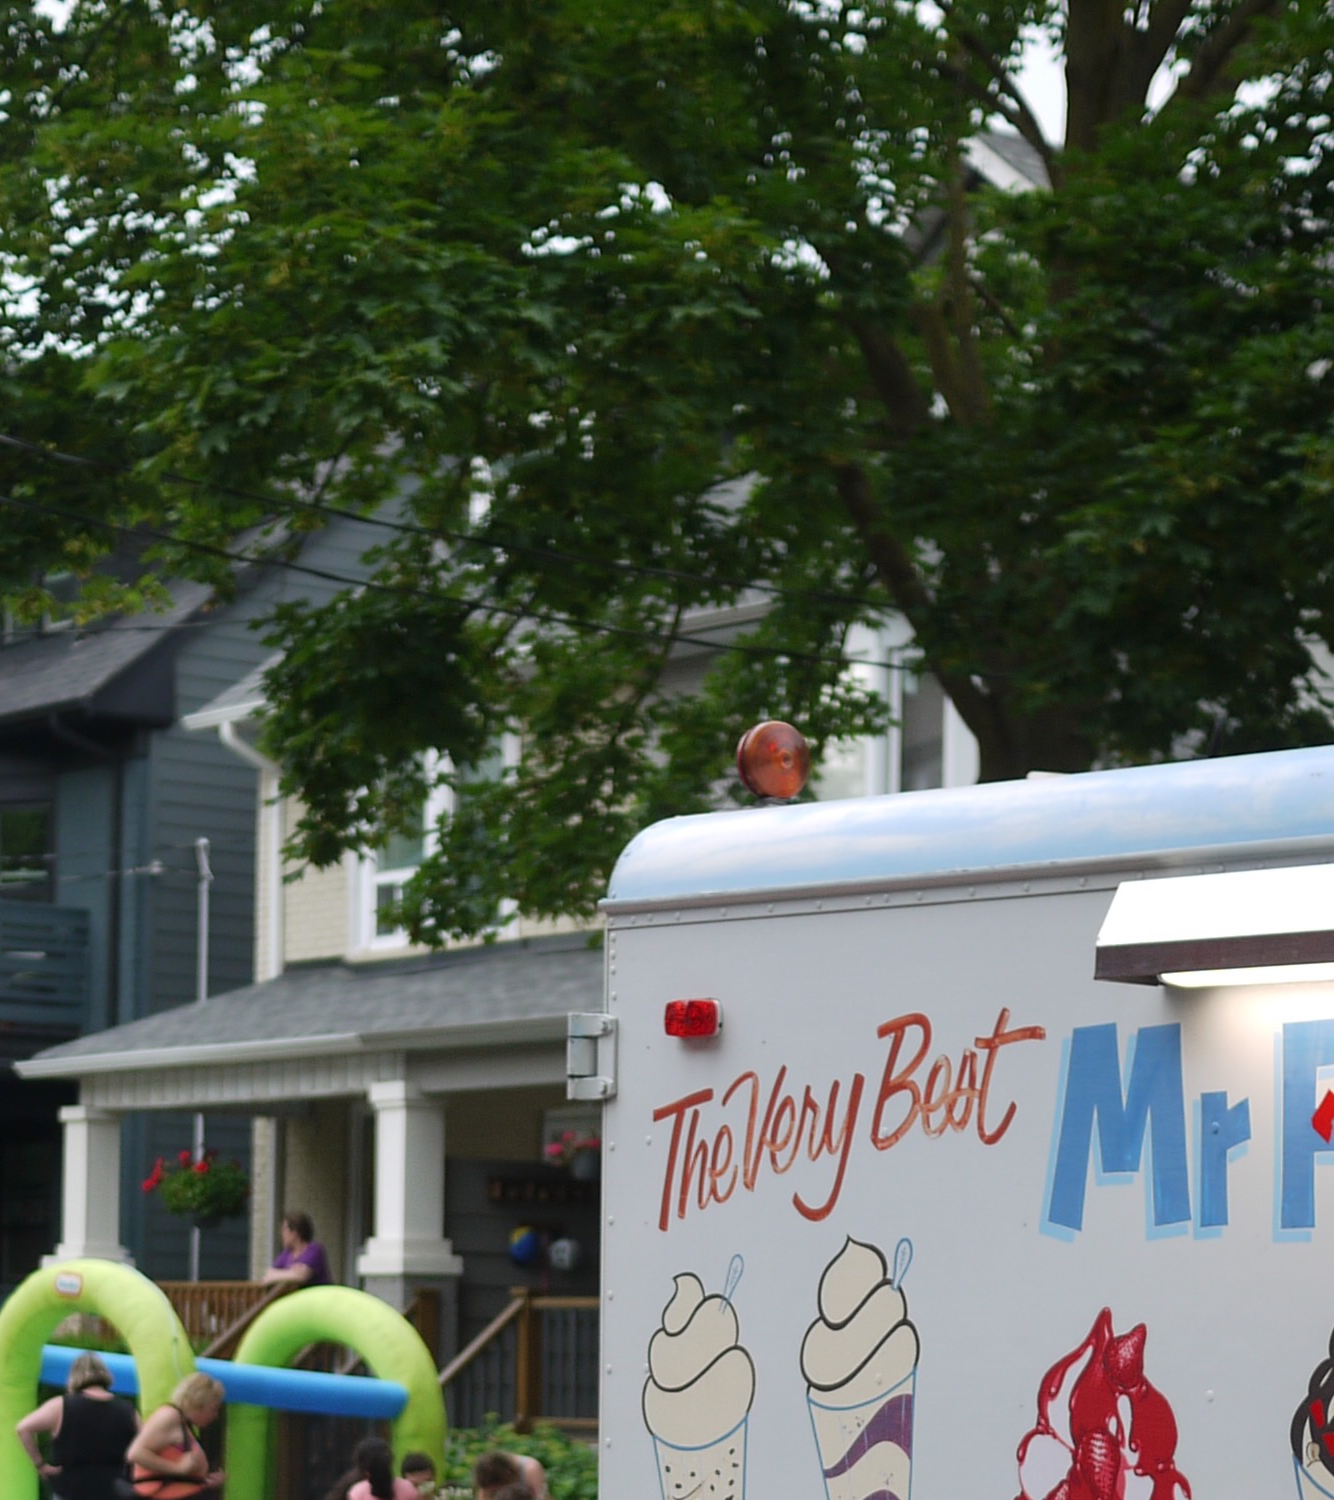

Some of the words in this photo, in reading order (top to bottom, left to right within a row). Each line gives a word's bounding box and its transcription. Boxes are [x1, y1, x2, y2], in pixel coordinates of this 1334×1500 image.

[653, 1088, 738, 1232] The
[722, 1064, 865, 1222] Very
[876, 1006, 1047, 1152] Best
[1039, 1021, 1253, 1243] Mr
